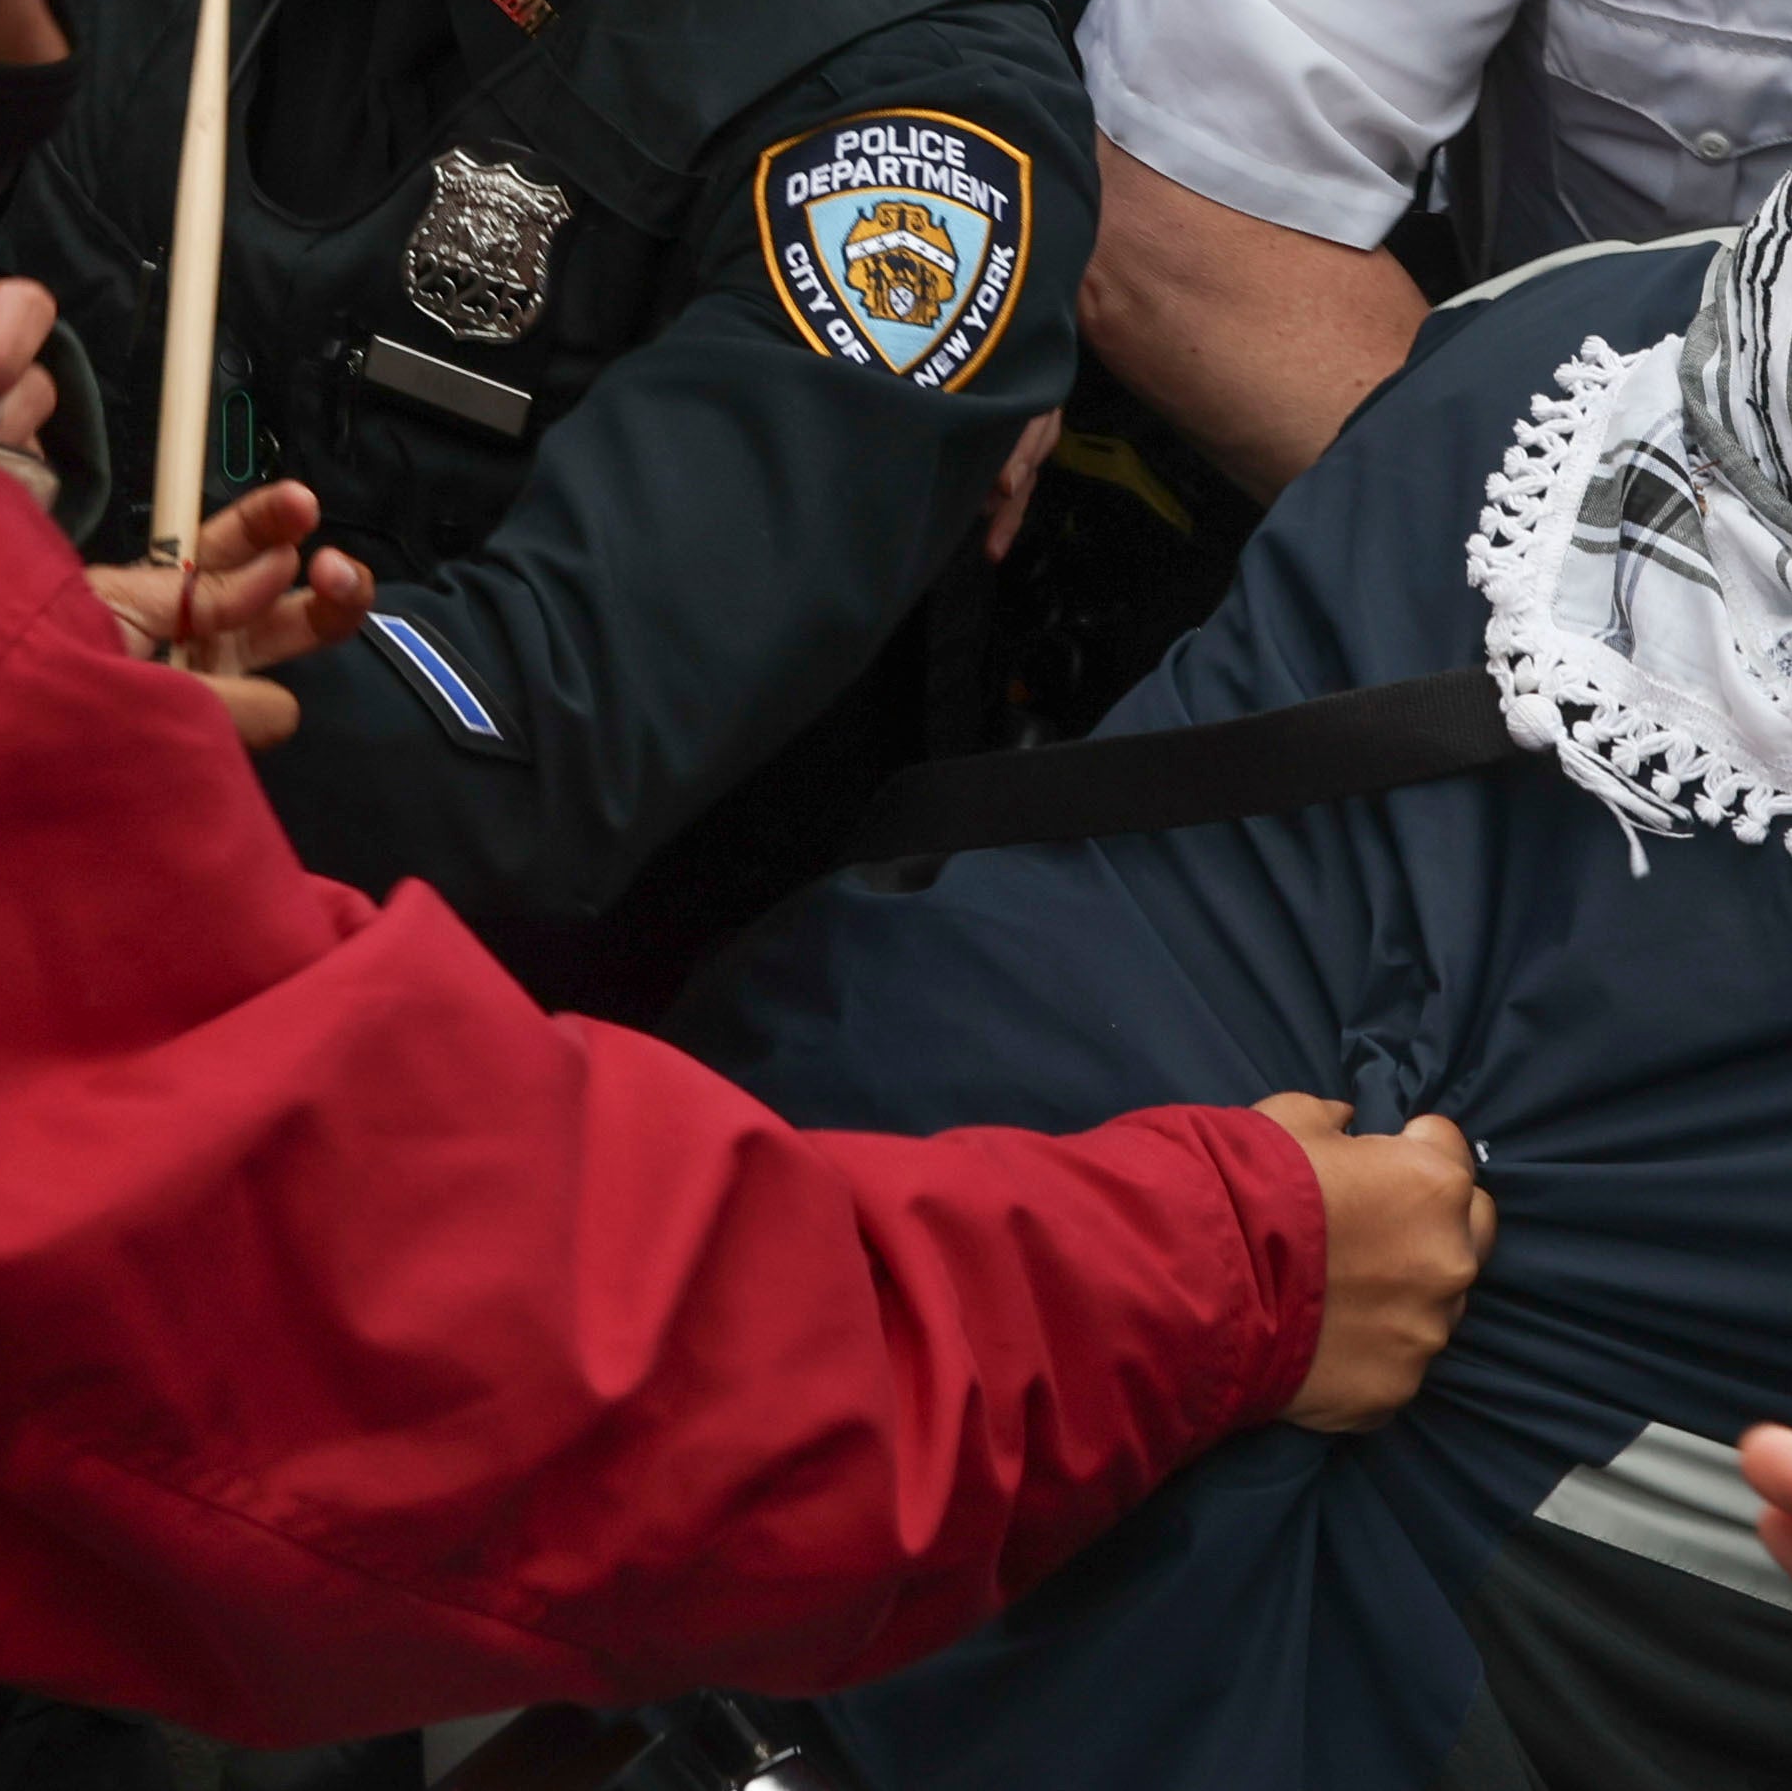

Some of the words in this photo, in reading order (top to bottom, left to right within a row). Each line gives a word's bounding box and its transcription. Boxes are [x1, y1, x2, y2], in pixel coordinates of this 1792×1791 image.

[786, 157, 1009, 222] DEPARTMENT
[836, 126, 966, 169] POLICE
[785, 242, 837, 314] CITY
[826, 319, 872, 366] OF
[913, 329, 972, 389] NEW
[965, 244, 1015, 331] YORK
